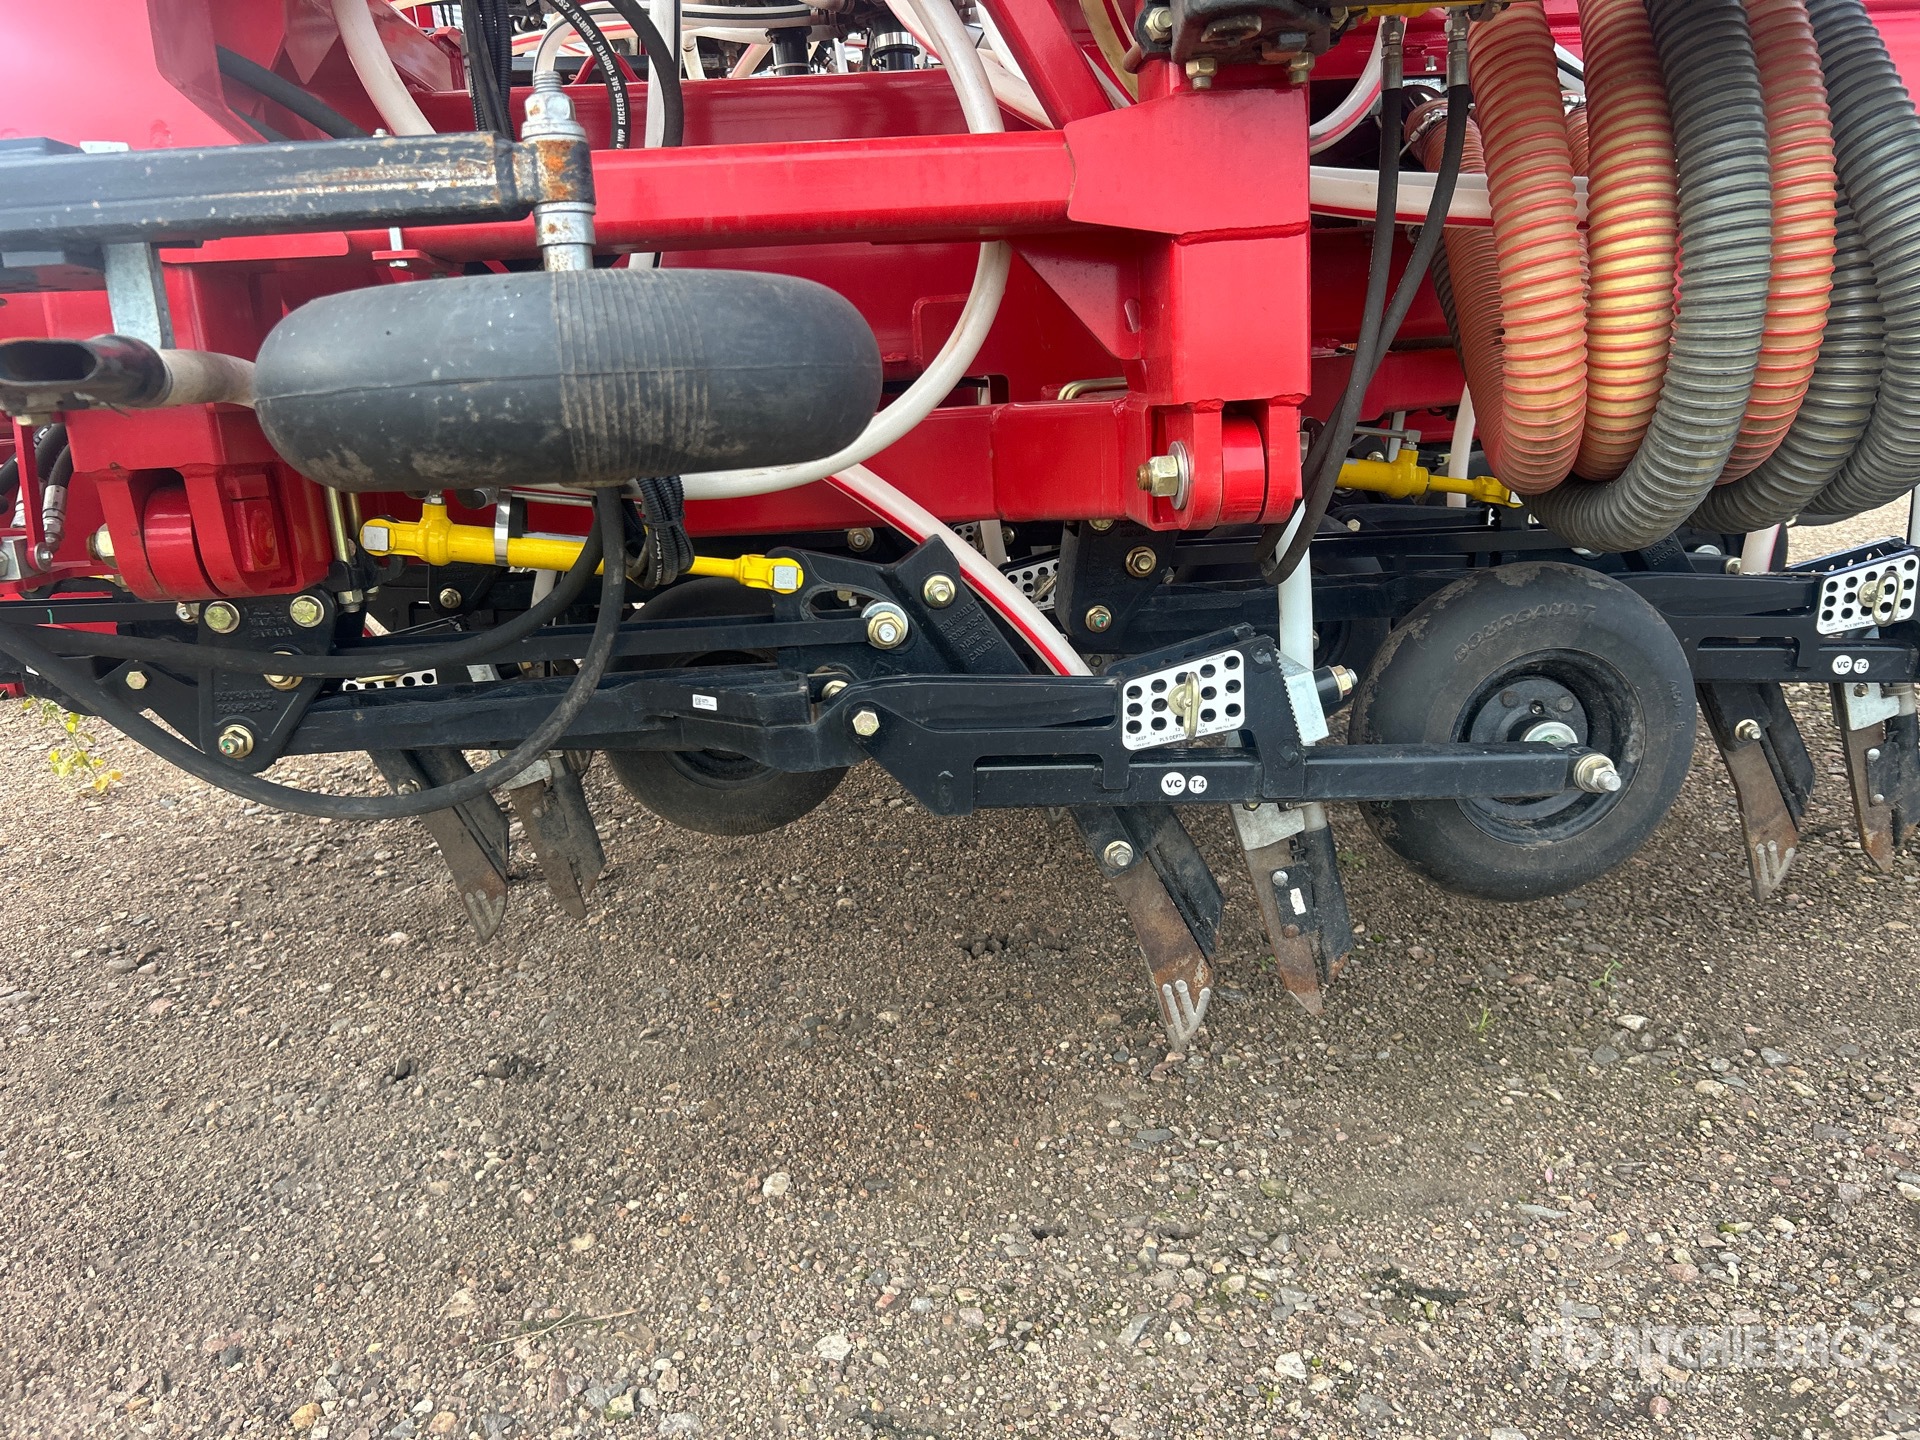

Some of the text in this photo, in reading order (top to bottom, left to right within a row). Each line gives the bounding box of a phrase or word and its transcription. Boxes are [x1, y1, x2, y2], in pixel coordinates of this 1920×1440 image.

[571, 10, 596, 41] 100R19
[596, 45, 616, 76] 100R16
[610, 75, 622, 92] SAE
[616, 92, 626, 125] EXCEEDS
[938, 600, 978, 633] BOURGAULT
[959, 624, 992, 651] MADE IN
[1454, 602, 1597, 663] BOURGAULT
[968, 637, 999, 661] CANADA
[1856, 662, 1867, 670] T4
[1165, 779, 1182, 788] VC
[1191, 779, 1205, 789] T4
